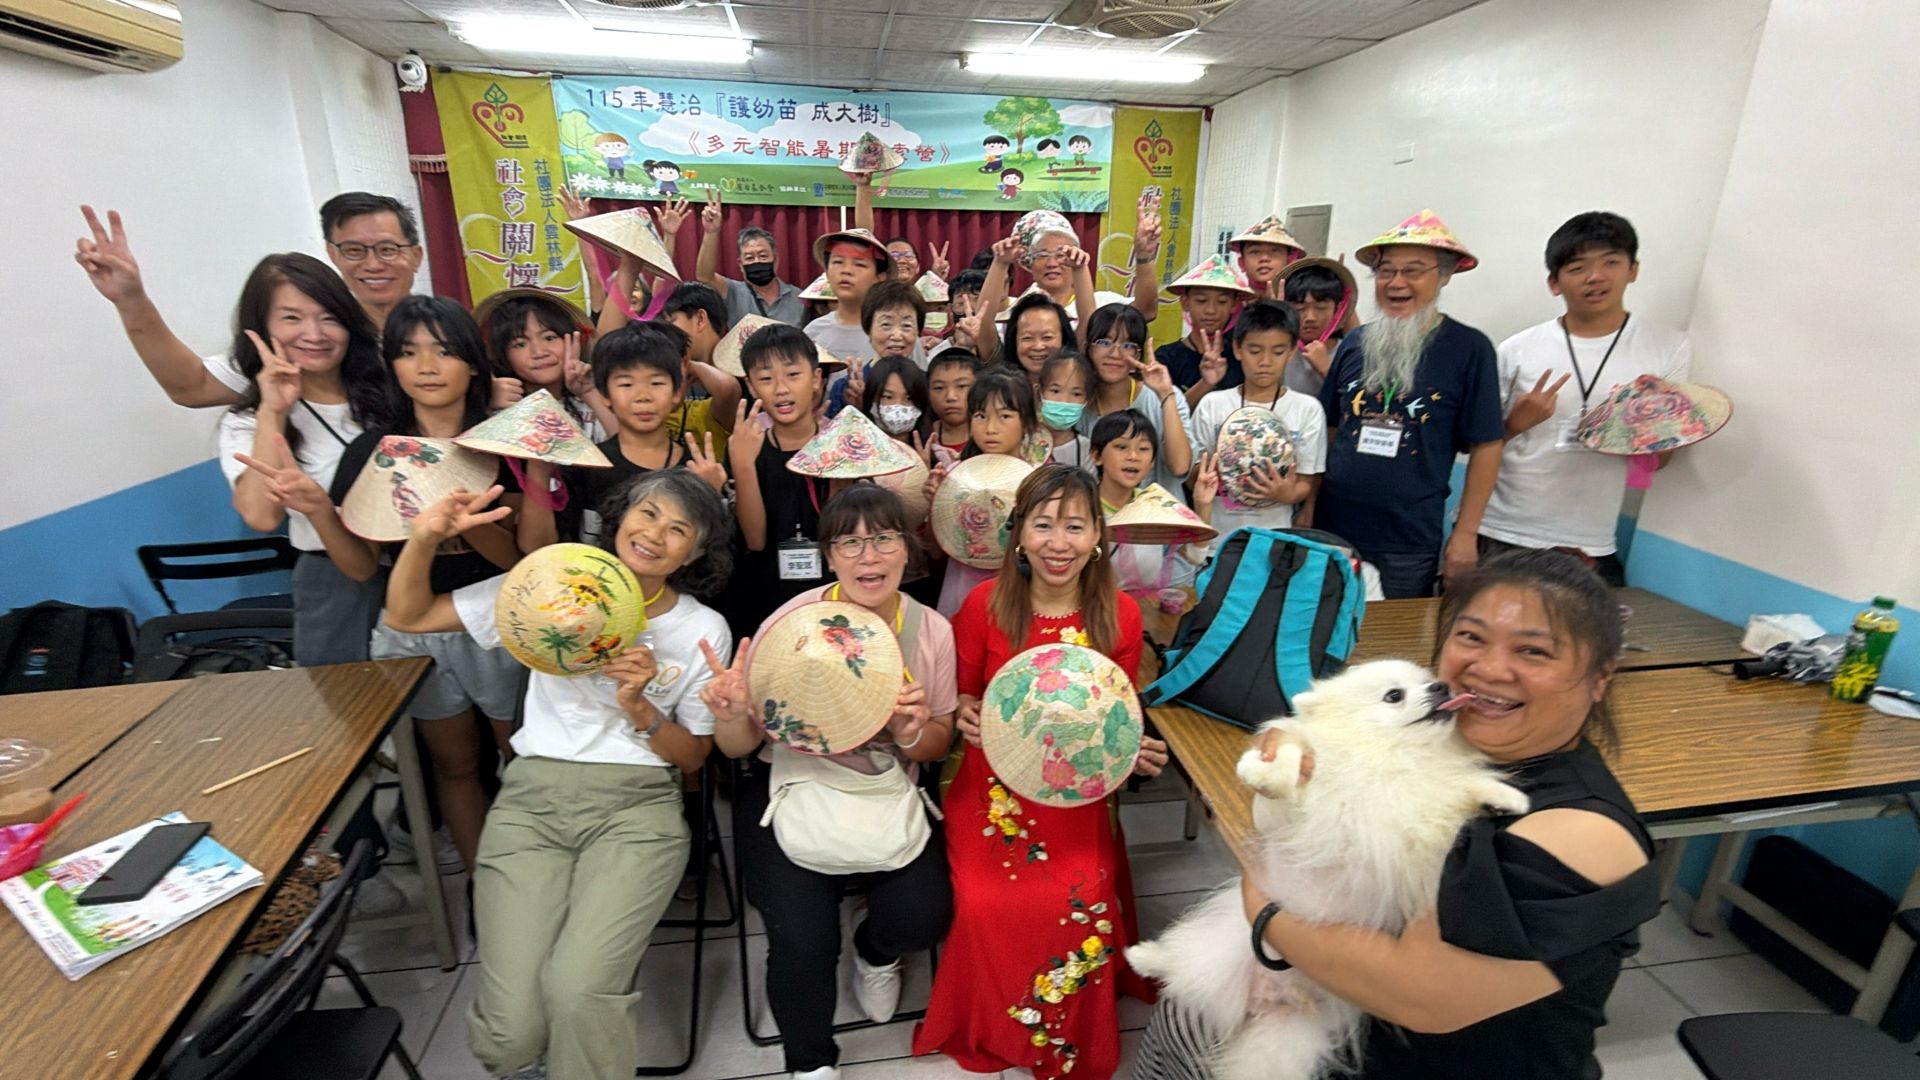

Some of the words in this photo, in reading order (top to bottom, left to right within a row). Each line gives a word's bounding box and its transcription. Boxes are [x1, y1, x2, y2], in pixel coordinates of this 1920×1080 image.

[496, 159, 540, 288] 社會關懷
[534, 158, 564, 272] 社團法人雲林縣
